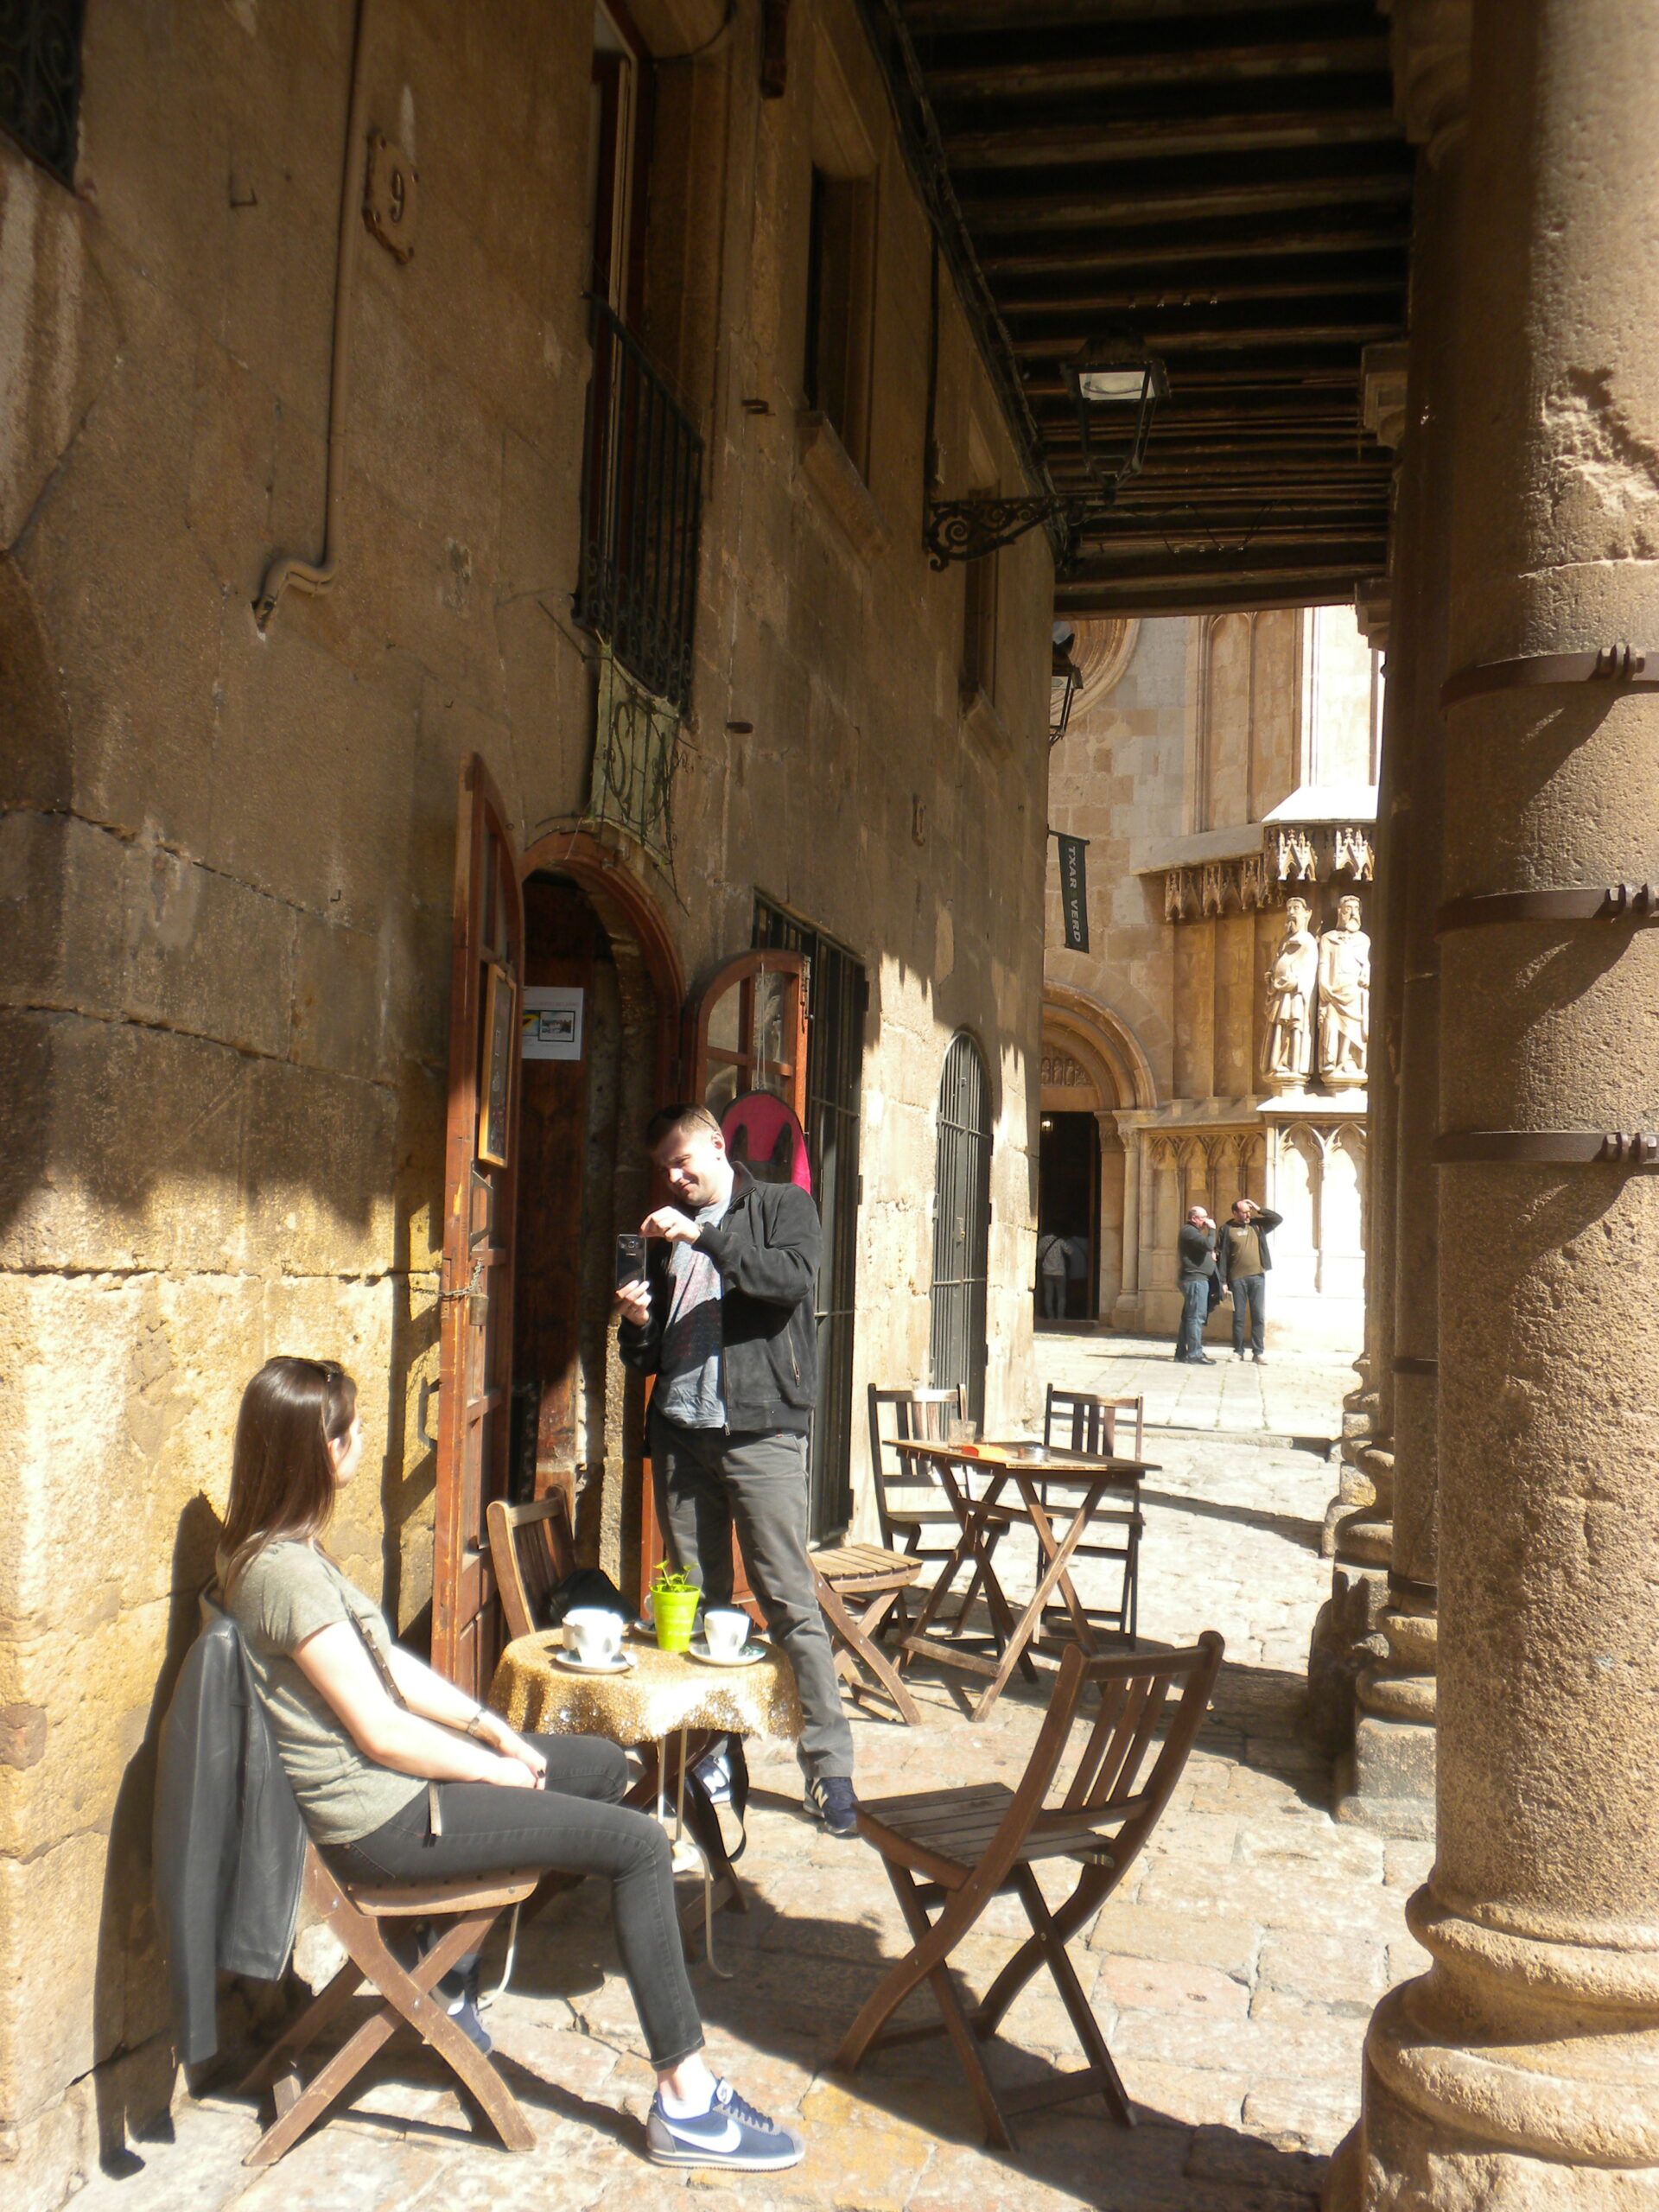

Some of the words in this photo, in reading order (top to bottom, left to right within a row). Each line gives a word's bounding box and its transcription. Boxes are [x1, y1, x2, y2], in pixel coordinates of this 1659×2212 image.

[1066, 847, 1077, 888] TXAR
[1071, 899, 1082, 943] VERD
[814, 1784, 829, 1808] N
